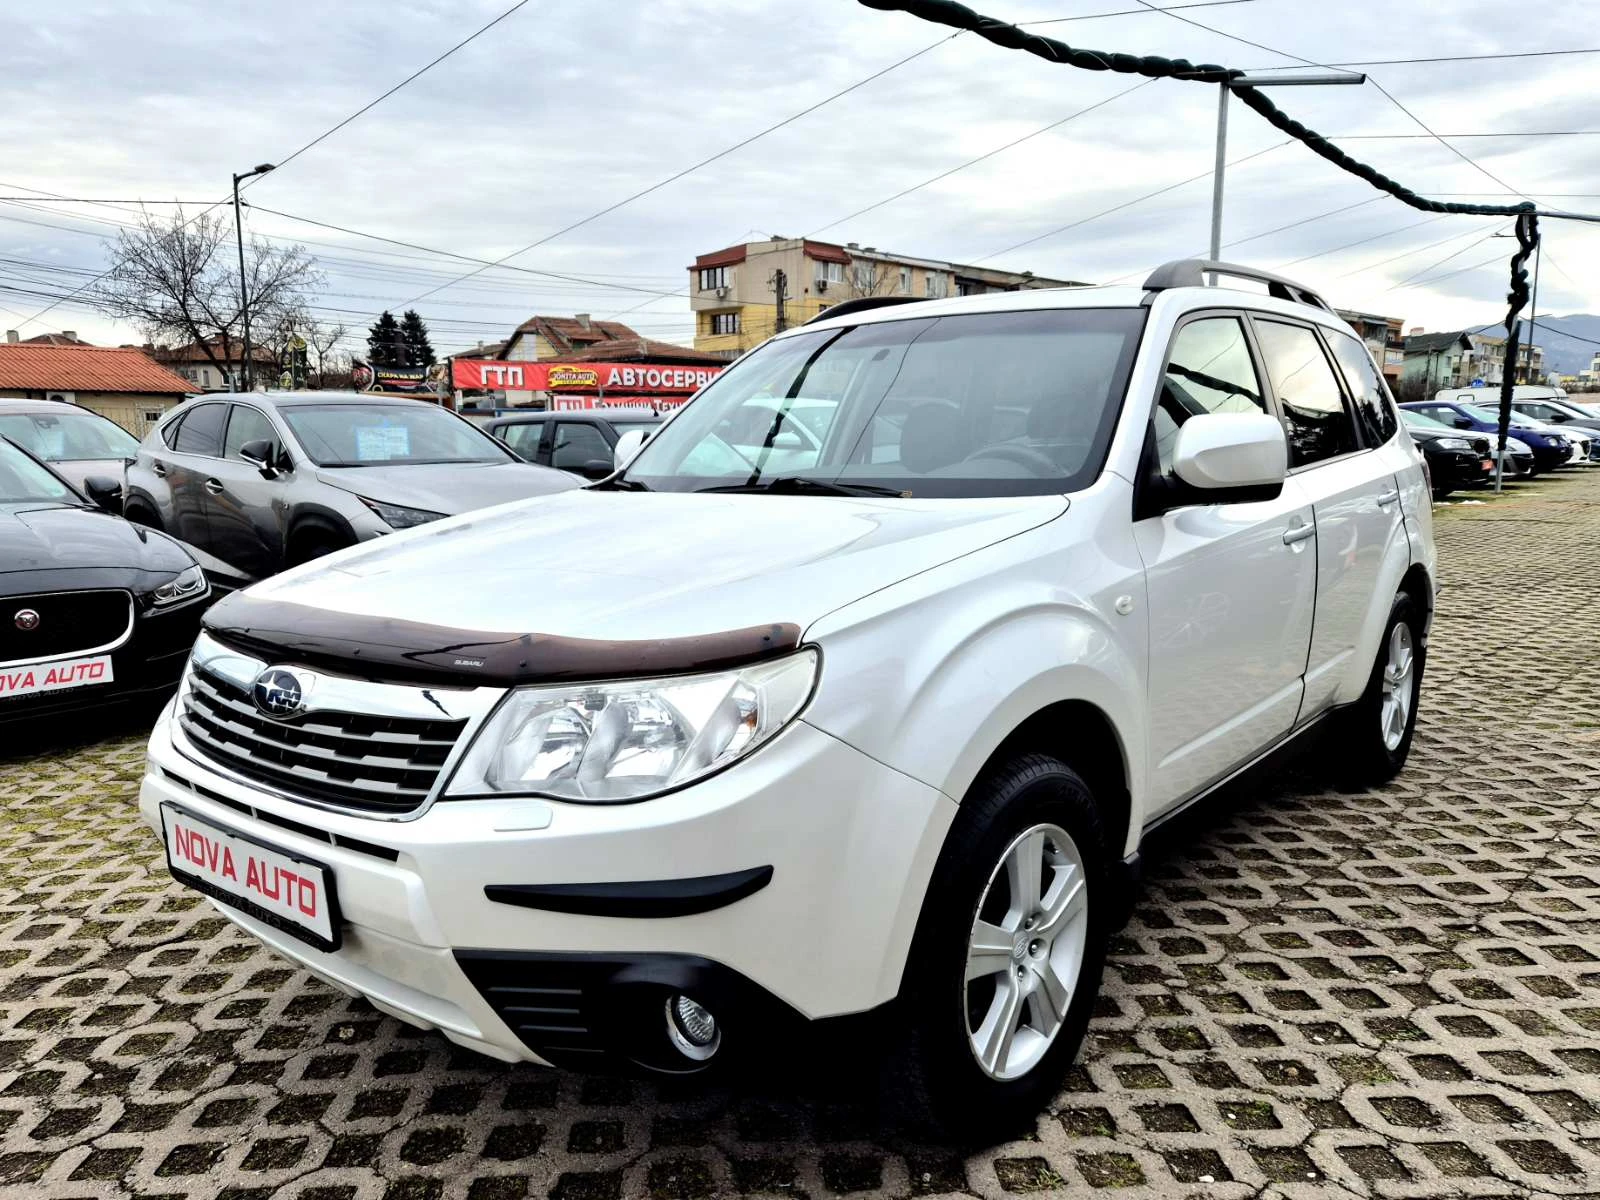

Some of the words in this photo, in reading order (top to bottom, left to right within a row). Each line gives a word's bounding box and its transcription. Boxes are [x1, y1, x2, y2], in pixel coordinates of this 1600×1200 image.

[481, 366, 523, 386] ГТП
[44, 662, 105, 685] AUTO
[175, 823, 238, 882] NOVA
[246, 855, 316, 918] AUTO
